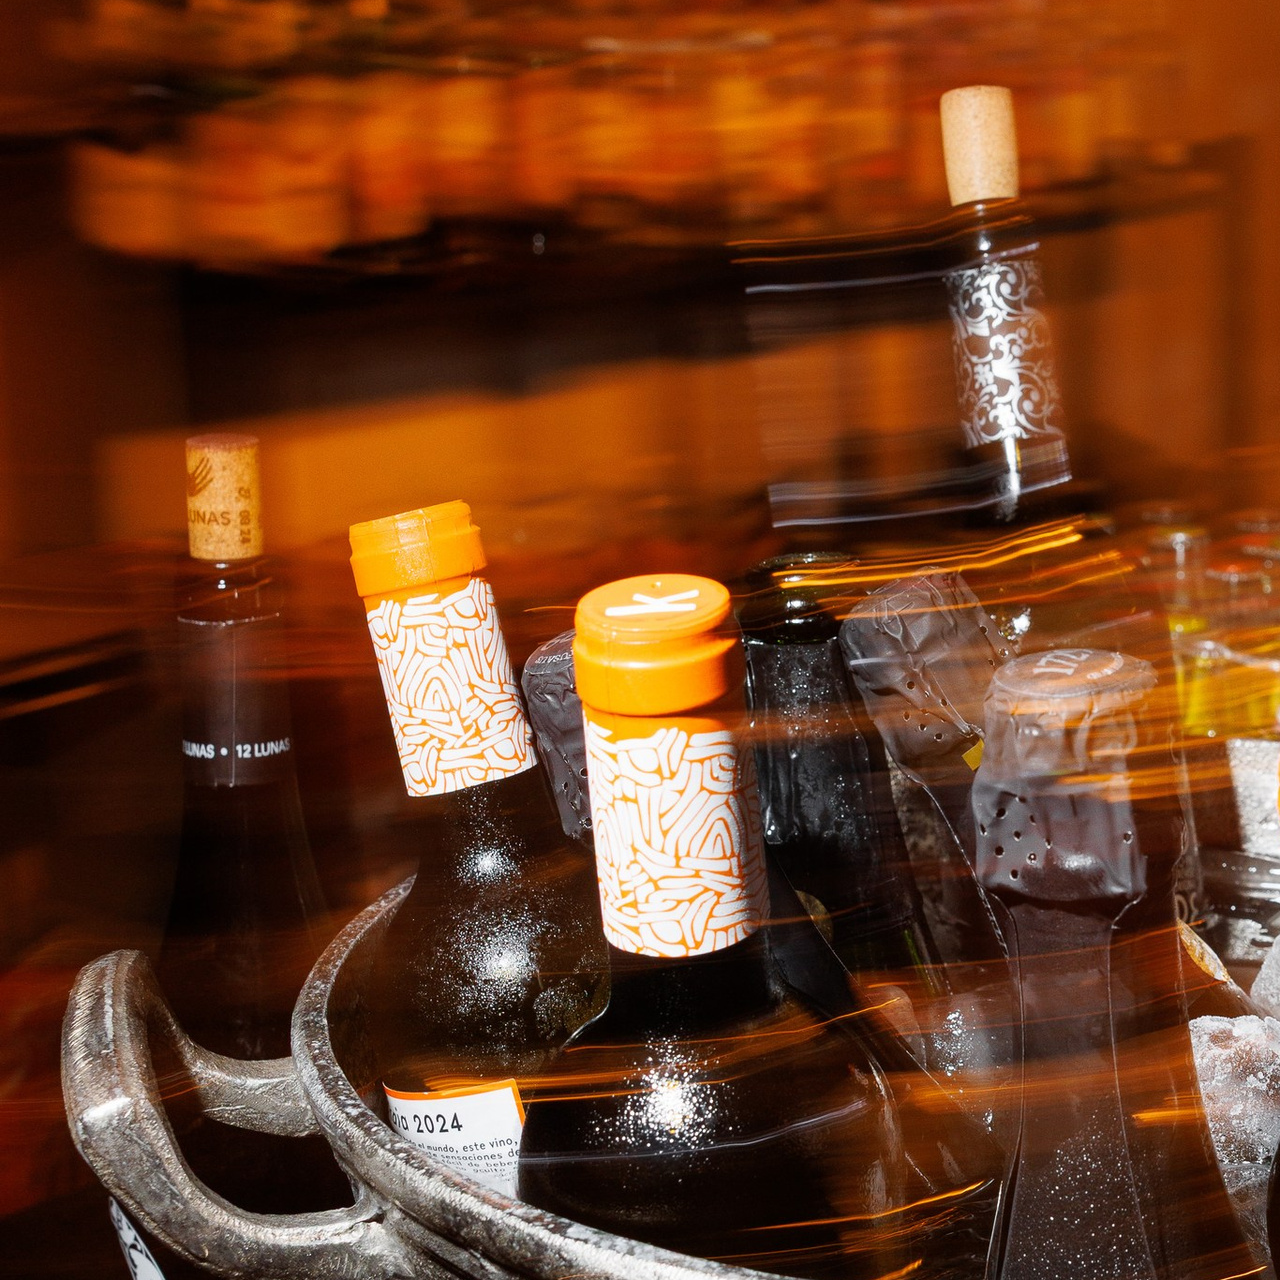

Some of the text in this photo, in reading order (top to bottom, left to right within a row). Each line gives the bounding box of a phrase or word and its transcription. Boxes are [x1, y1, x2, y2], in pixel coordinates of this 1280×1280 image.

[188, 508, 231, 527] UNAS
[235, 743, 252, 759] 12
[254, 737, 291, 758] LUNAS
[413, 1112, 463, 1134] 2024
[426, 1143, 459, 1154] mundo,
[462, 1141, 486, 1153] este
[488, 1137, 519, 1148] vino,
